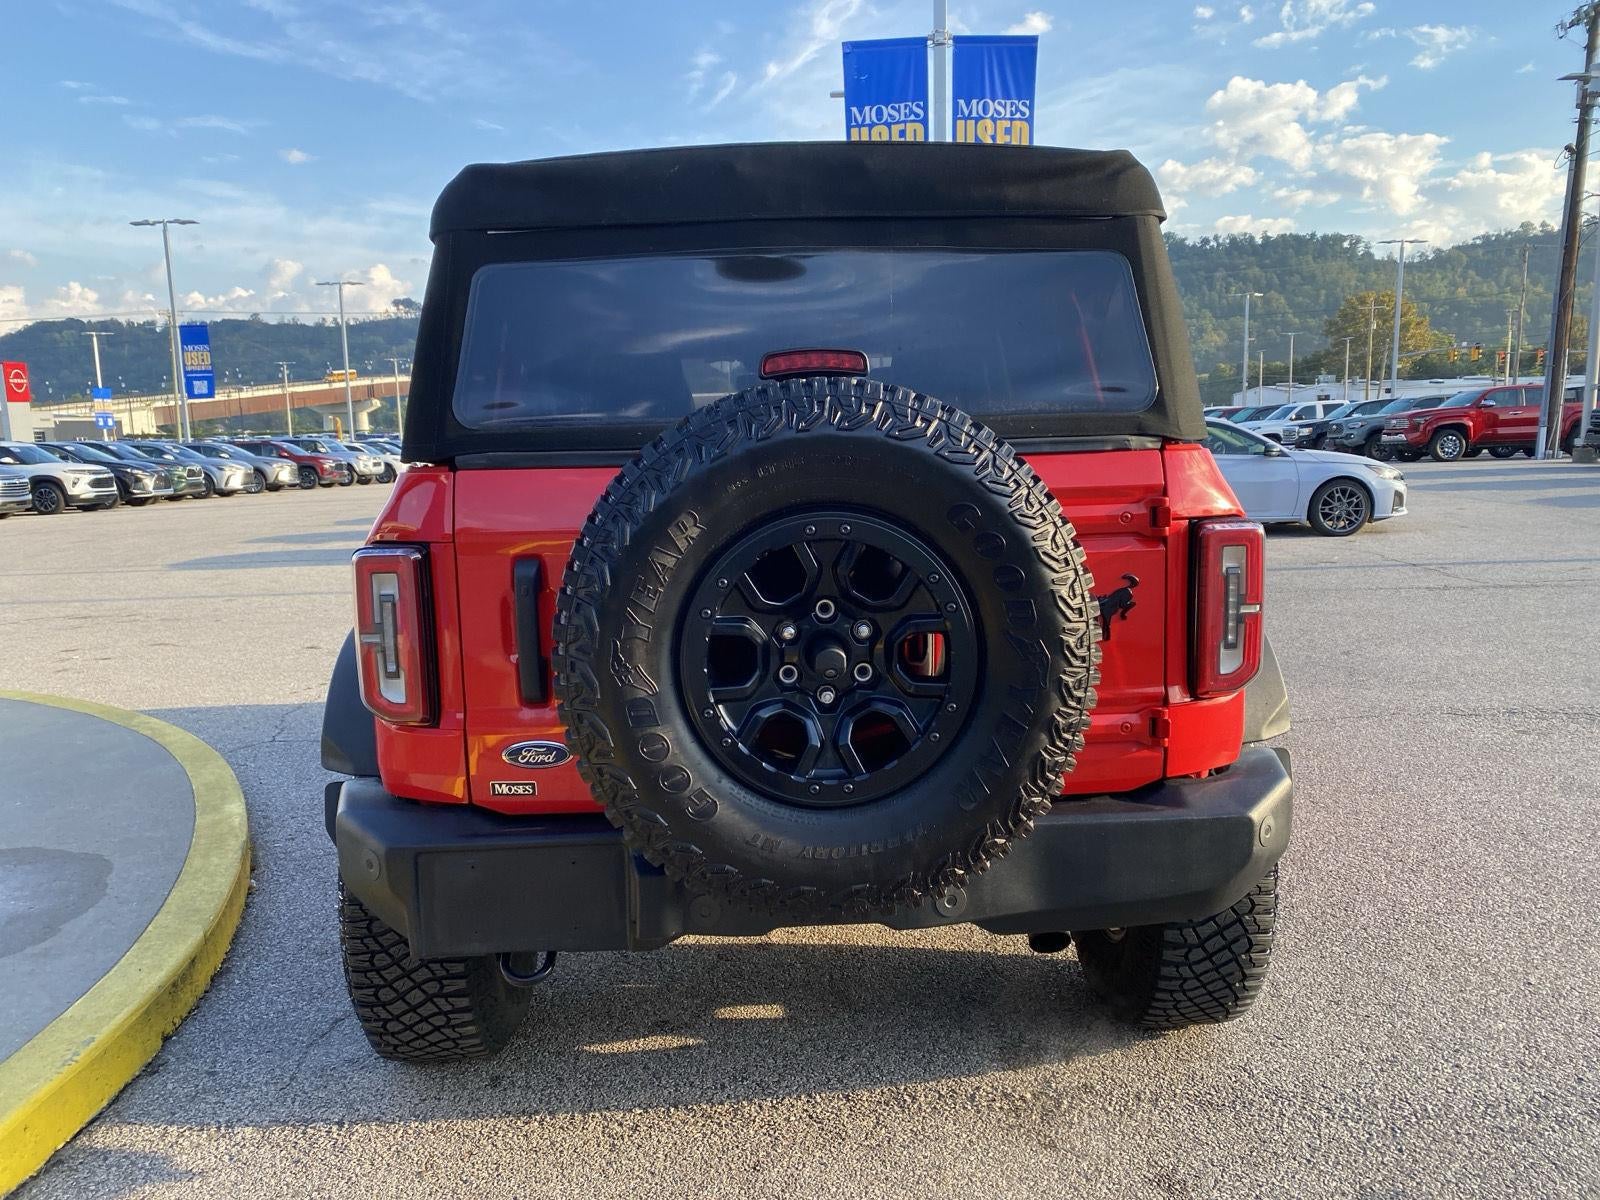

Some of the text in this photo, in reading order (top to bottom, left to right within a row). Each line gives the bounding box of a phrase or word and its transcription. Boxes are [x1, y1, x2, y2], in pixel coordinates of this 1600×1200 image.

[850, 101, 925, 125] MOSES
[957, 98, 1030, 119] MOSES
[183, 344, 210, 352] MOSES
[184, 351, 212, 366] USED
[518, 747, 557, 763] Ford
